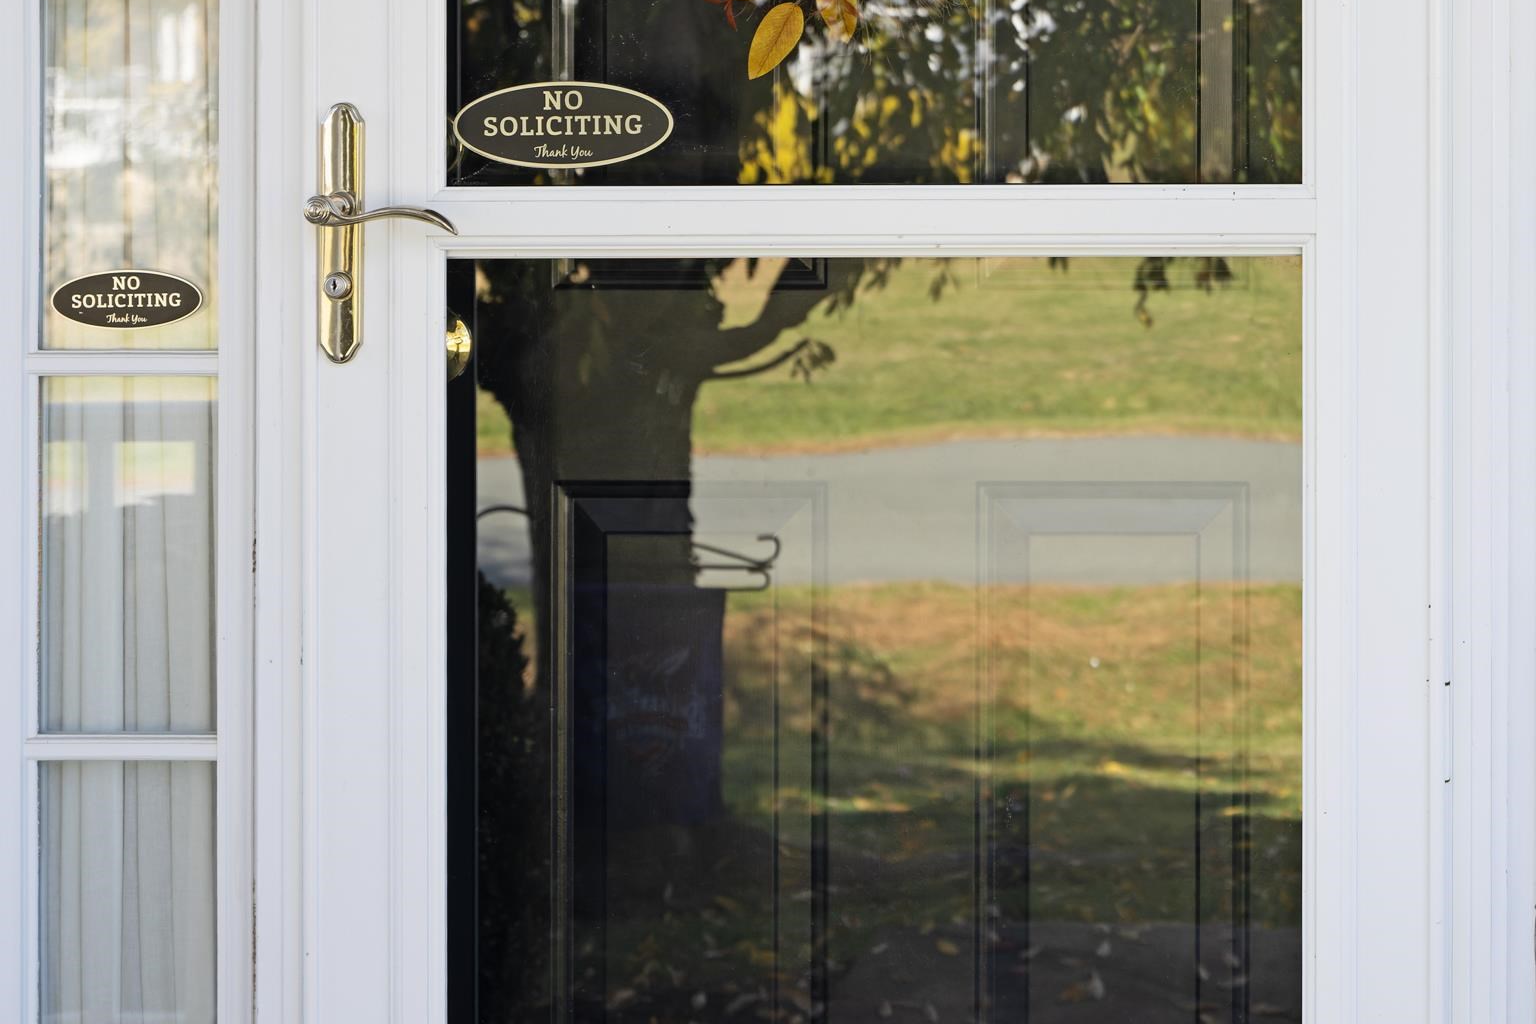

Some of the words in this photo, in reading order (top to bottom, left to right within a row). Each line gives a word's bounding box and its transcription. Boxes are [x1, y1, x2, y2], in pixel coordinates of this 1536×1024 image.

[543, 90, 583, 110] NO
[483, 114, 643, 137] SOLICITING
[533, 144, 568, 158] Thank
[571, 145, 593, 160] You
[112, 276, 140, 290] NO
[71, 293, 182, 308] SOLICITING
[106, 313, 130, 323] Thank
[131, 314, 147, 324] You
